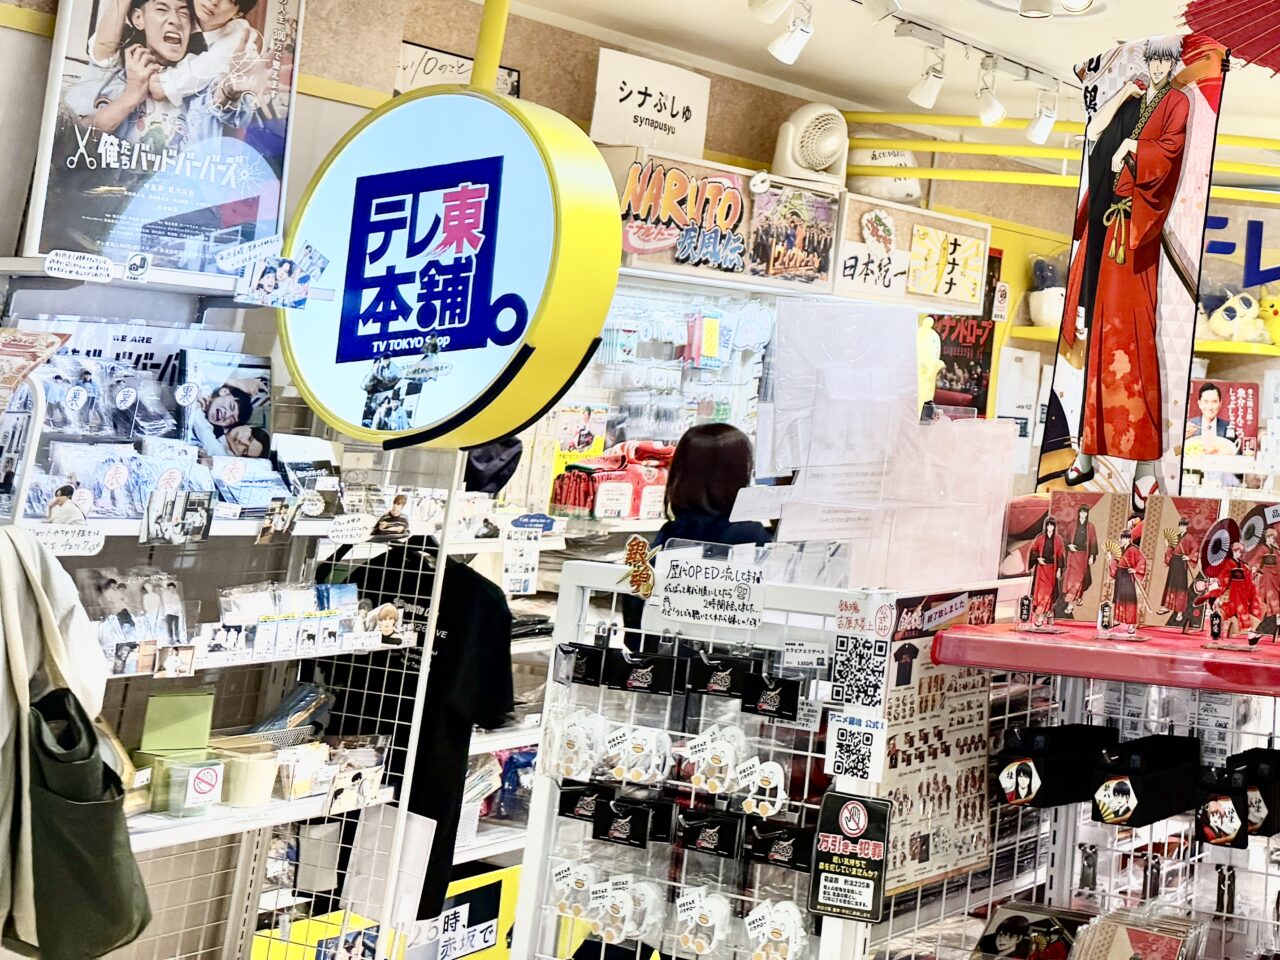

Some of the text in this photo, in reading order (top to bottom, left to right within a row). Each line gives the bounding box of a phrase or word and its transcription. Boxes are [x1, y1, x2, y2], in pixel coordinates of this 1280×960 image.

[617, 80, 693, 123] シナぷしゅ
[632, 113, 677, 135] synapusyu
[97, 131, 244, 189] 俺たちバッドバーバーズ
[620, 159, 745, 235] NARUTO
[366, 183, 490, 266] テレ東
[675, 220, 745, 273] 疾風伝
[358, 255, 475, 334] 本舗
[130, 335, 153, 345] ARE
[372, 334, 450, 353] TV TOKYO Sop
